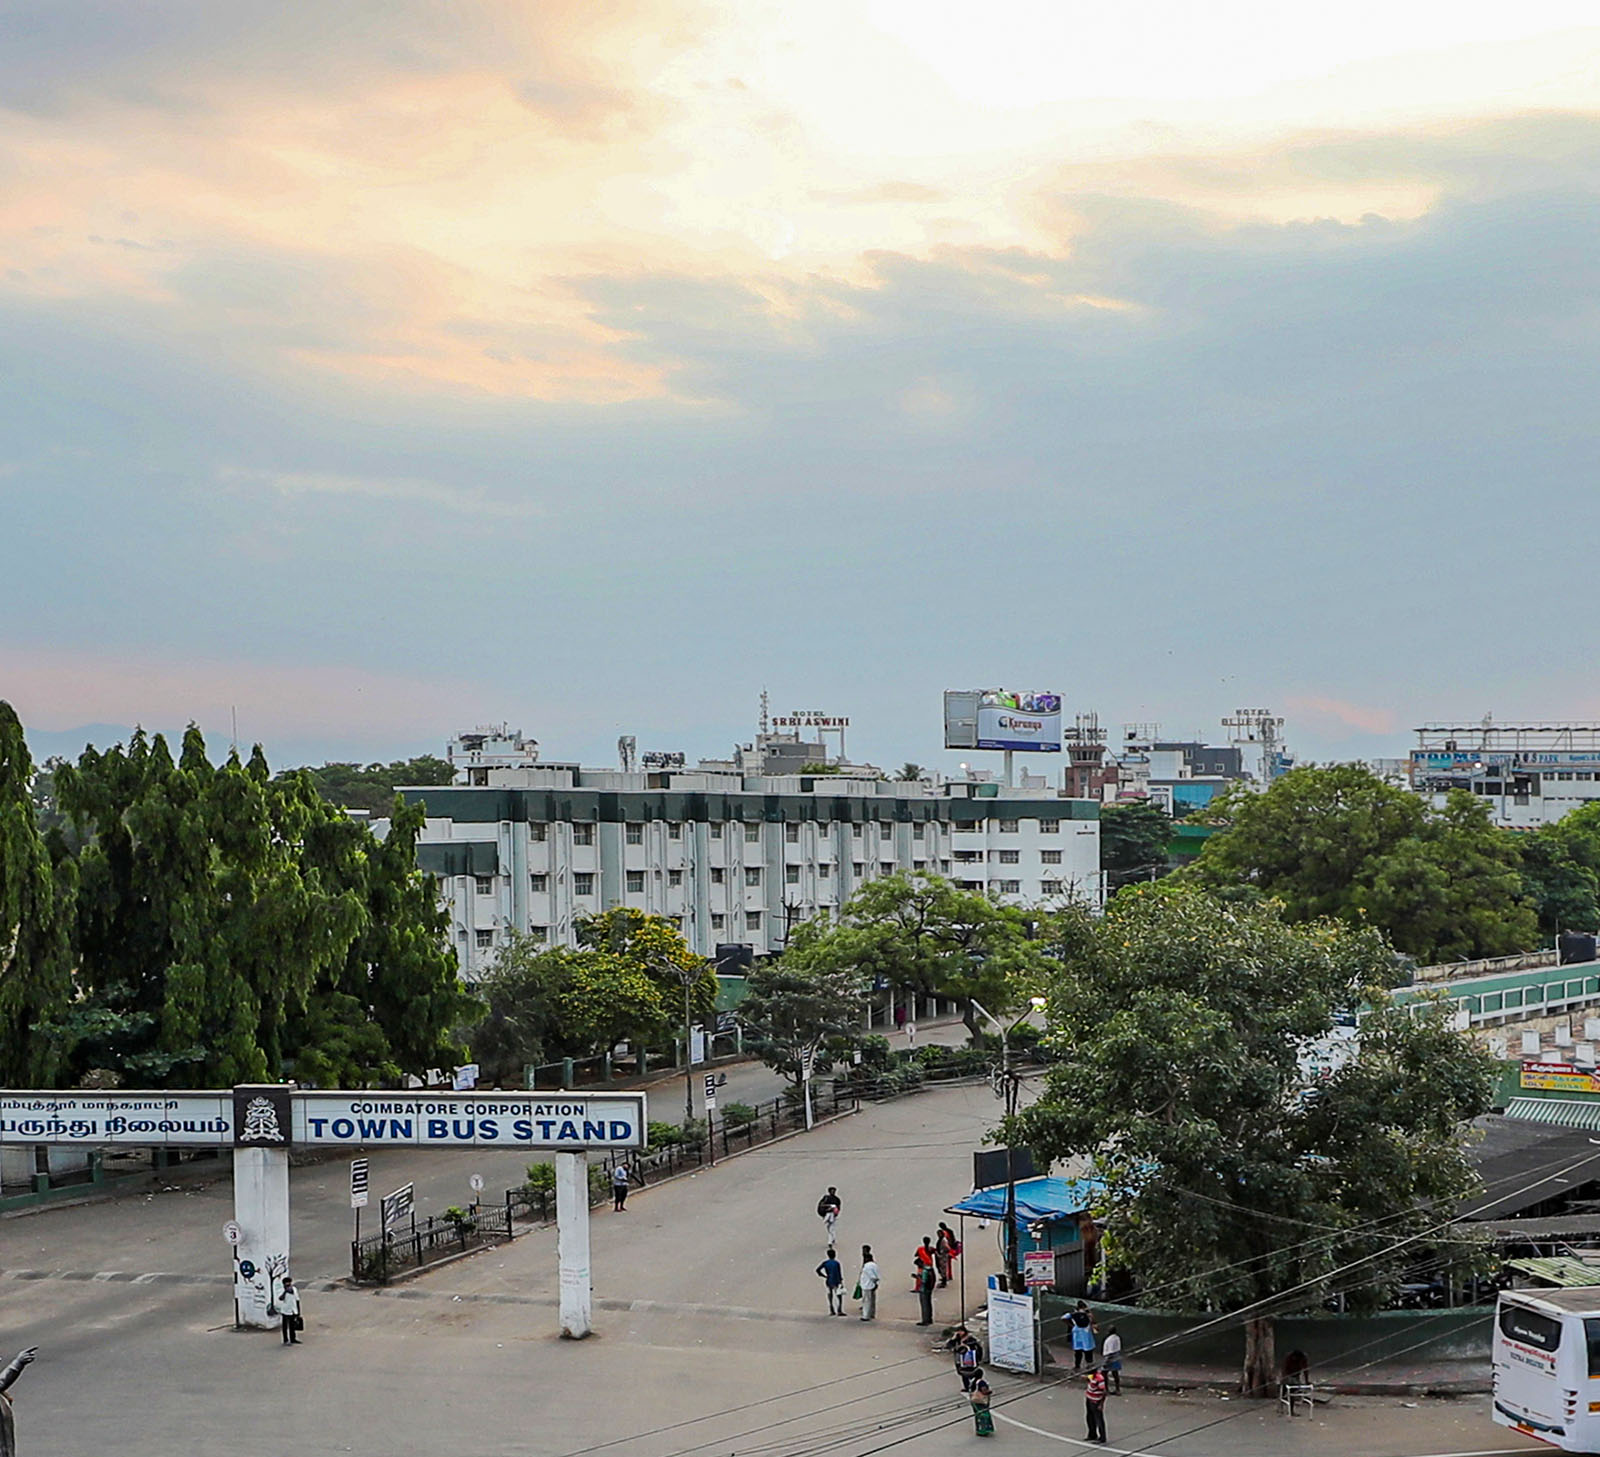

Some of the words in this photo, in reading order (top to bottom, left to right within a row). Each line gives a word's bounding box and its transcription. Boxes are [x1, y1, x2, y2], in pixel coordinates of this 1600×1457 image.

[805, 717, 850, 726] ASWINI
[81, 1098, 179, 1111] மாநகராட்சி
[350, 1102, 458, 1116] COIMBATORE
[464, 1103, 585, 1117] CORPORATION
[105, 1114, 231, 1137] நிலையம்
[308, 1118, 413, 1139] TOWN
[427, 1119, 499, 1140] BUS
[513, 1120, 632, 1141] STAND
